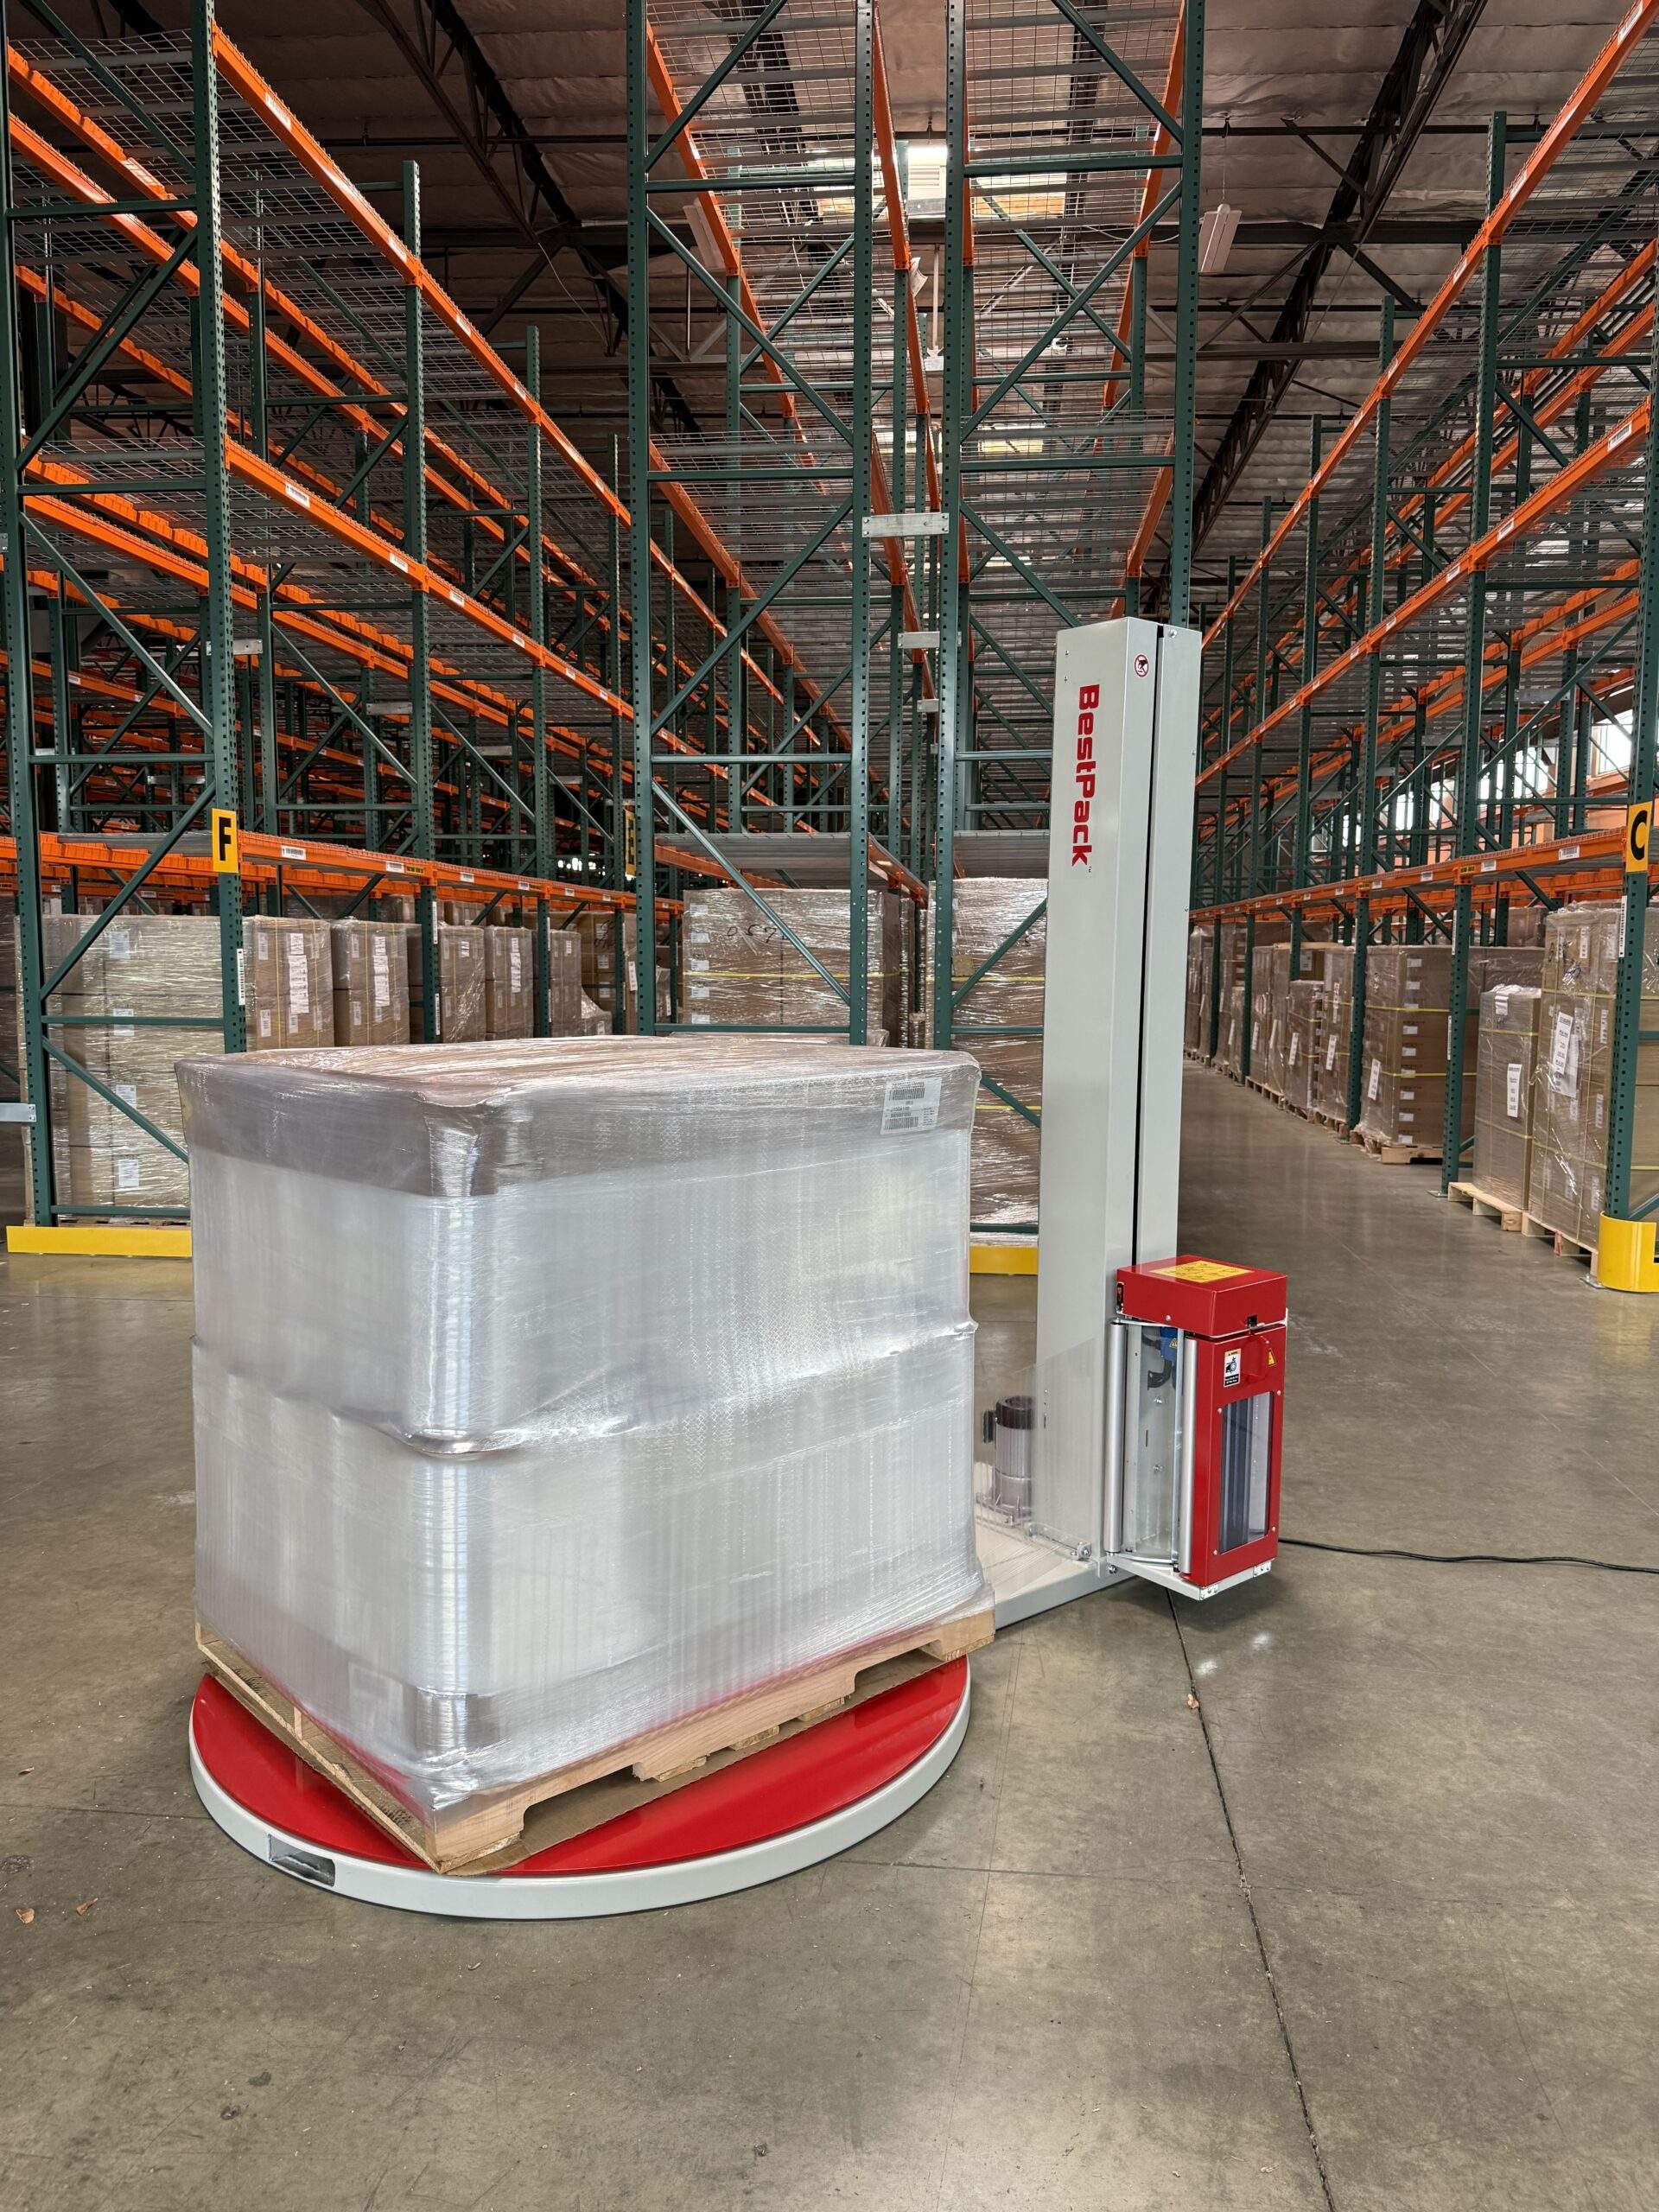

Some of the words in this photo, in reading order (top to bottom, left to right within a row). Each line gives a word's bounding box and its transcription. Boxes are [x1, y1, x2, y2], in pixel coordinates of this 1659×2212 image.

[1071, 683, 1100, 867] BestPack
[219, 817, 232, 861] F
[1630, 810, 1648, 861] C
